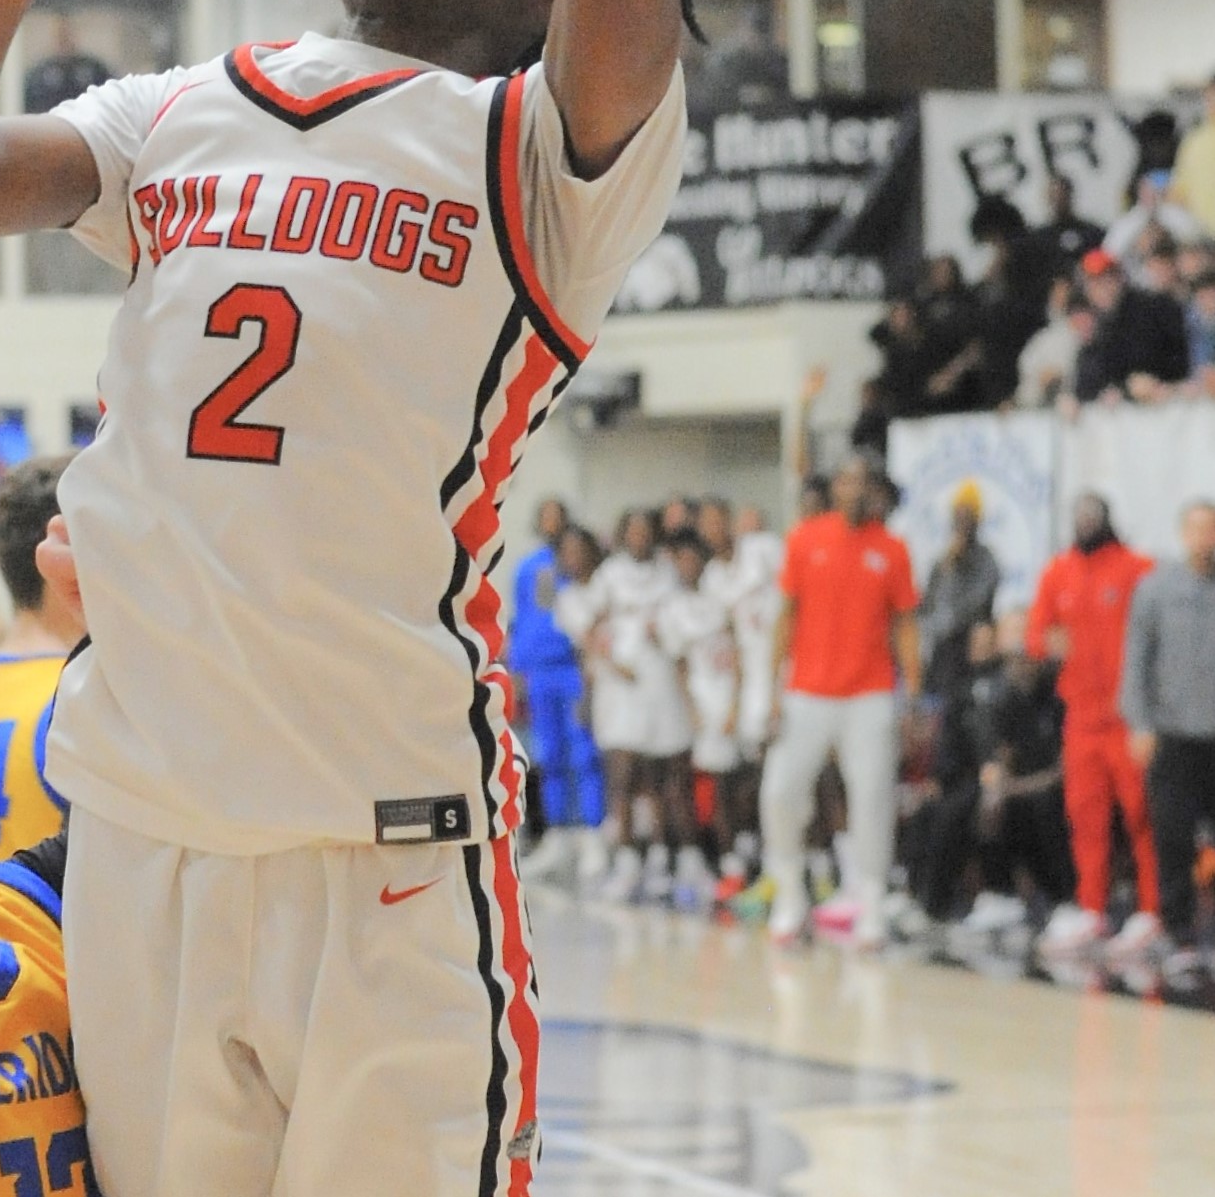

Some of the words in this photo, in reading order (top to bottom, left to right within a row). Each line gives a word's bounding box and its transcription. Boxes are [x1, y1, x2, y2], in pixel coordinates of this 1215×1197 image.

[134, 174, 479, 288] BULLDOGS
[186, 282, 302, 466] 2
[445, 809, 458, 829] S
